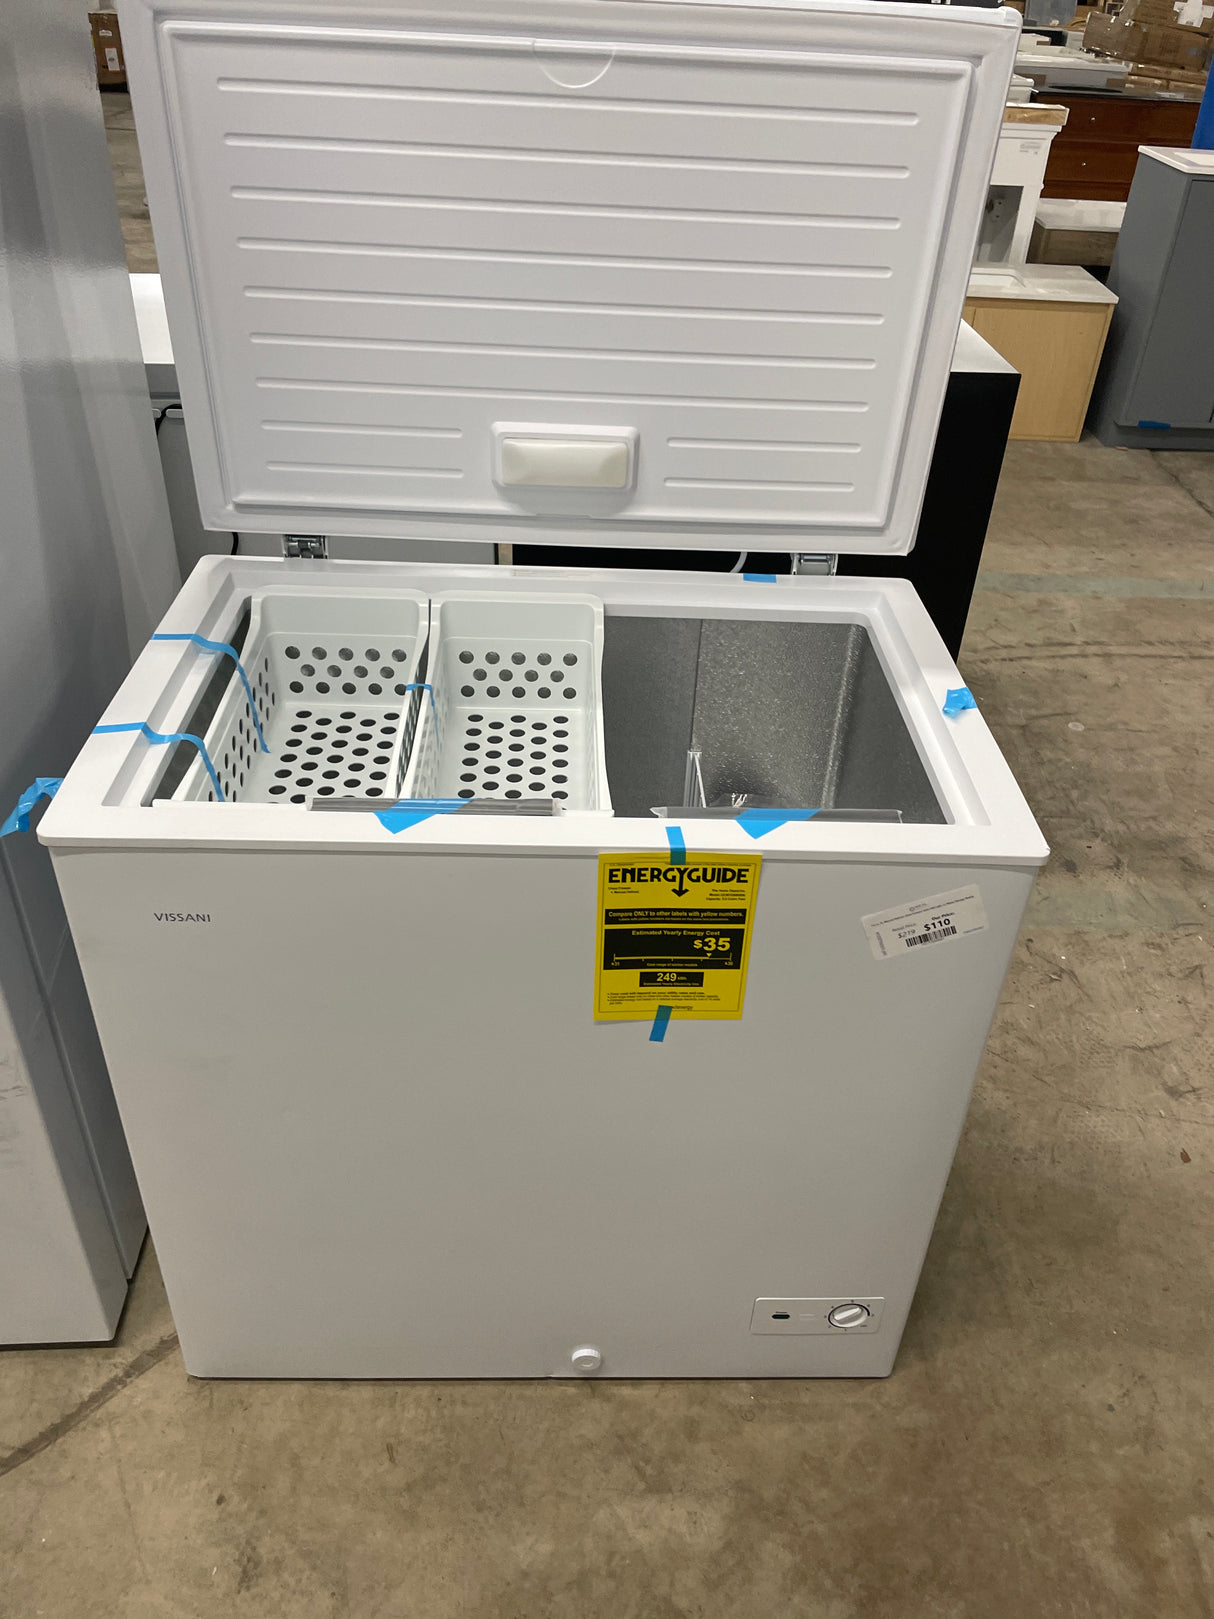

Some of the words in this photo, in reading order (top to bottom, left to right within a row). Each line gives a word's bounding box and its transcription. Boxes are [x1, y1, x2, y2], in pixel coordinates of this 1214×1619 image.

[608, 867, 750, 883] ENERGYGUIDE
[153, 912, 211, 922] VISSANI
[923, 918, 951, 932] $110
[898, 929, 916, 939] $219
[693, 937, 731, 951] $35
[656, 972, 677, 981] 249
